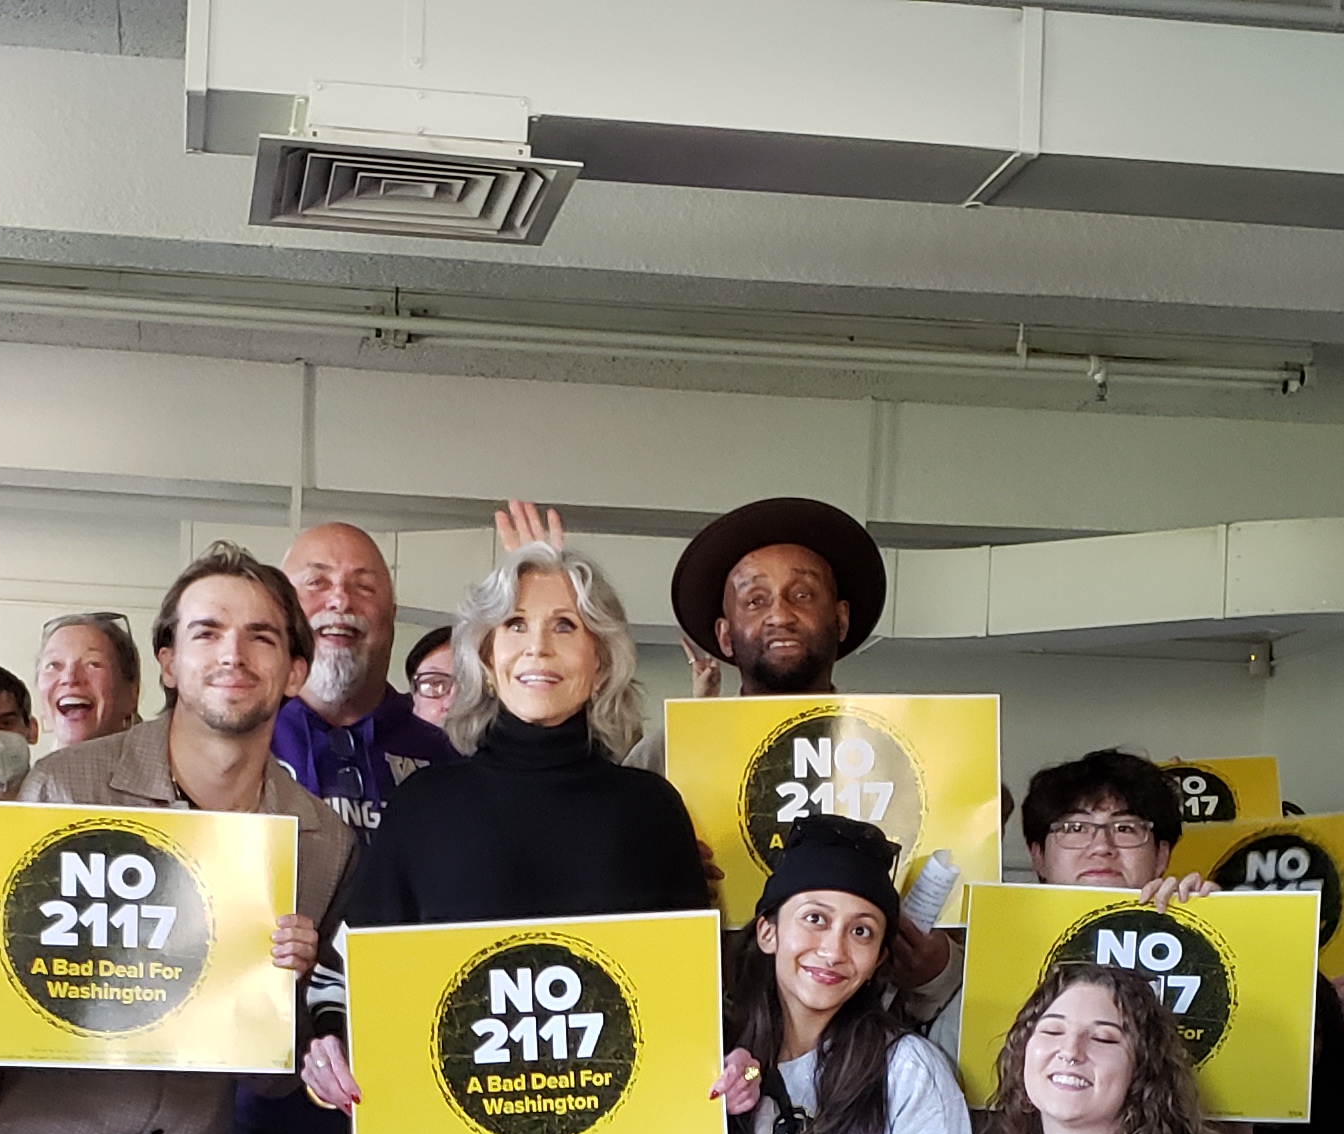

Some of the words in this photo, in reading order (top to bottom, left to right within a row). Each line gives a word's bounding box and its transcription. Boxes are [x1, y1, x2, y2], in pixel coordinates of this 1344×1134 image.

[794, 737, 875, 778] NO
[776, 781, 894, 823] 2117
[1173, 775, 1207, 796] O
[1180, 795, 1219, 817] 17
[769, 833, 784, 849] A
[60, 852, 156, 900] NO
[1245, 846, 1311, 882] NO
[39, 900, 177, 949] 2117
[30, 957, 49, 976] A
[52, 958, 94, 977] Bad
[98, 960, 145, 979] Deal
[149, 962, 183, 980] For
[1096, 929, 1183, 972] NO
[46, 980, 167, 1004] Washington
[489, 965, 582, 1015] NO
[471, 1012, 605, 1065] 2117
[466, 1077, 484, 1094] A
[487, 1074, 526, 1093] Bad
[531, 1071, 576, 1090] Deal
[580, 1069, 613, 1088] For
[481, 1094, 599, 1115] Washington
